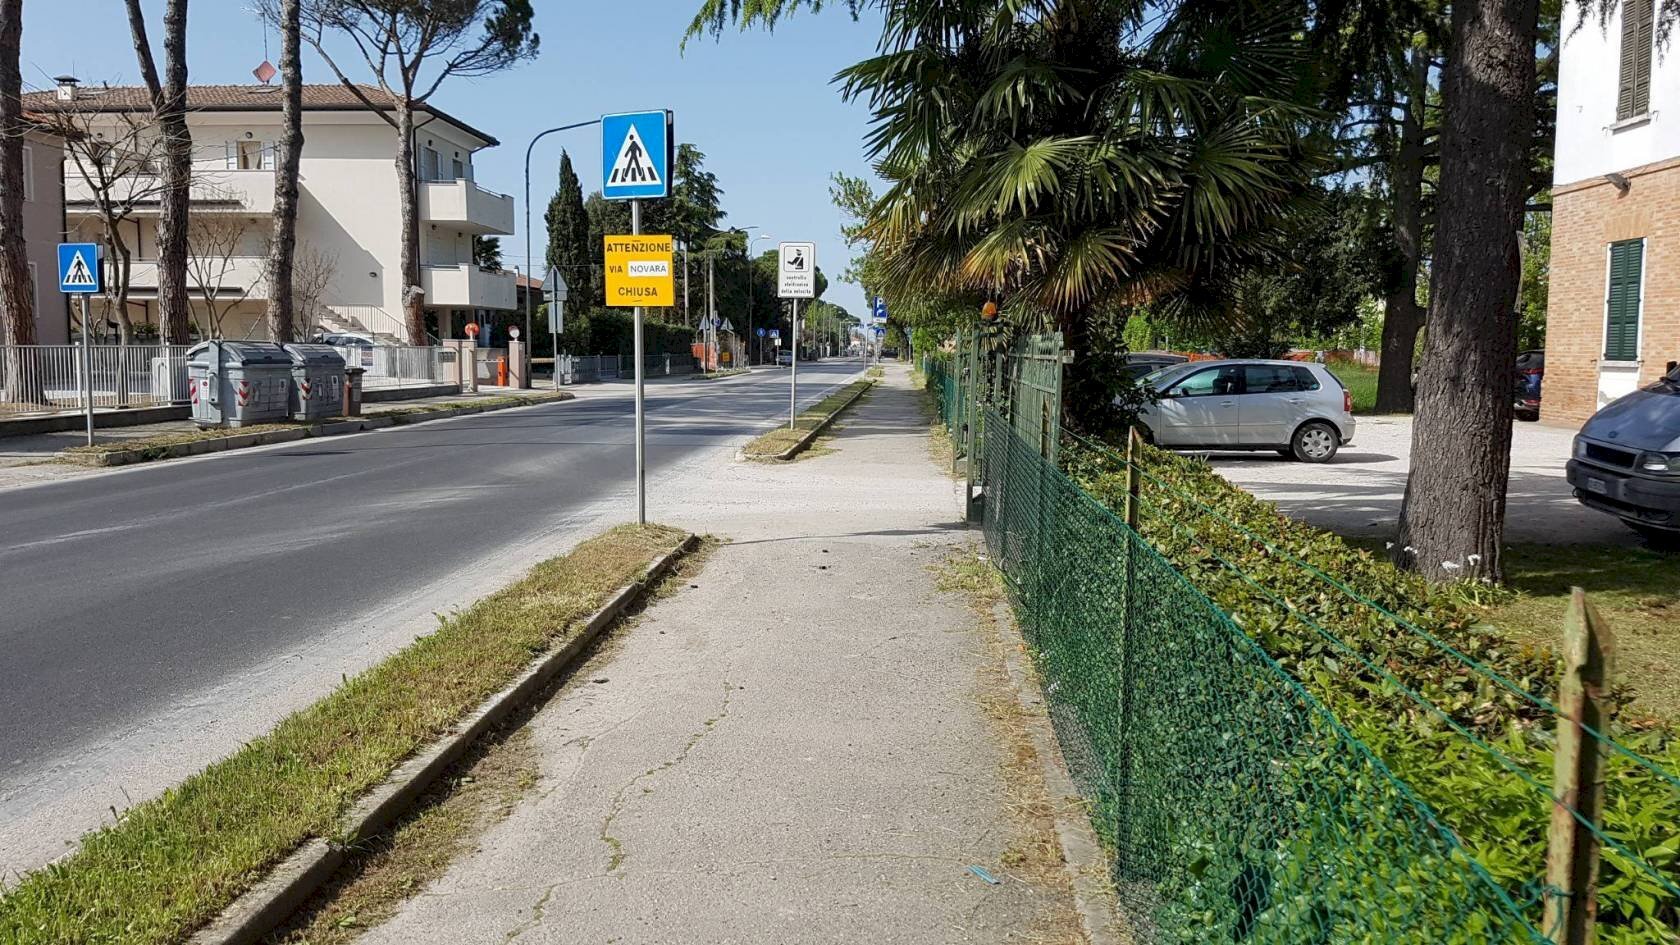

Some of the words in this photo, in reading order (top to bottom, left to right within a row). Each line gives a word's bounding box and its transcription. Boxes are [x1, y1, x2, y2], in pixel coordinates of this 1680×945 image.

[606, 243, 671, 252] ATTENZIONE
[609, 265, 623, 273] VIA
[630, 265, 667, 273] NOVARA
[618, 287, 658, 297] CHIUSA
